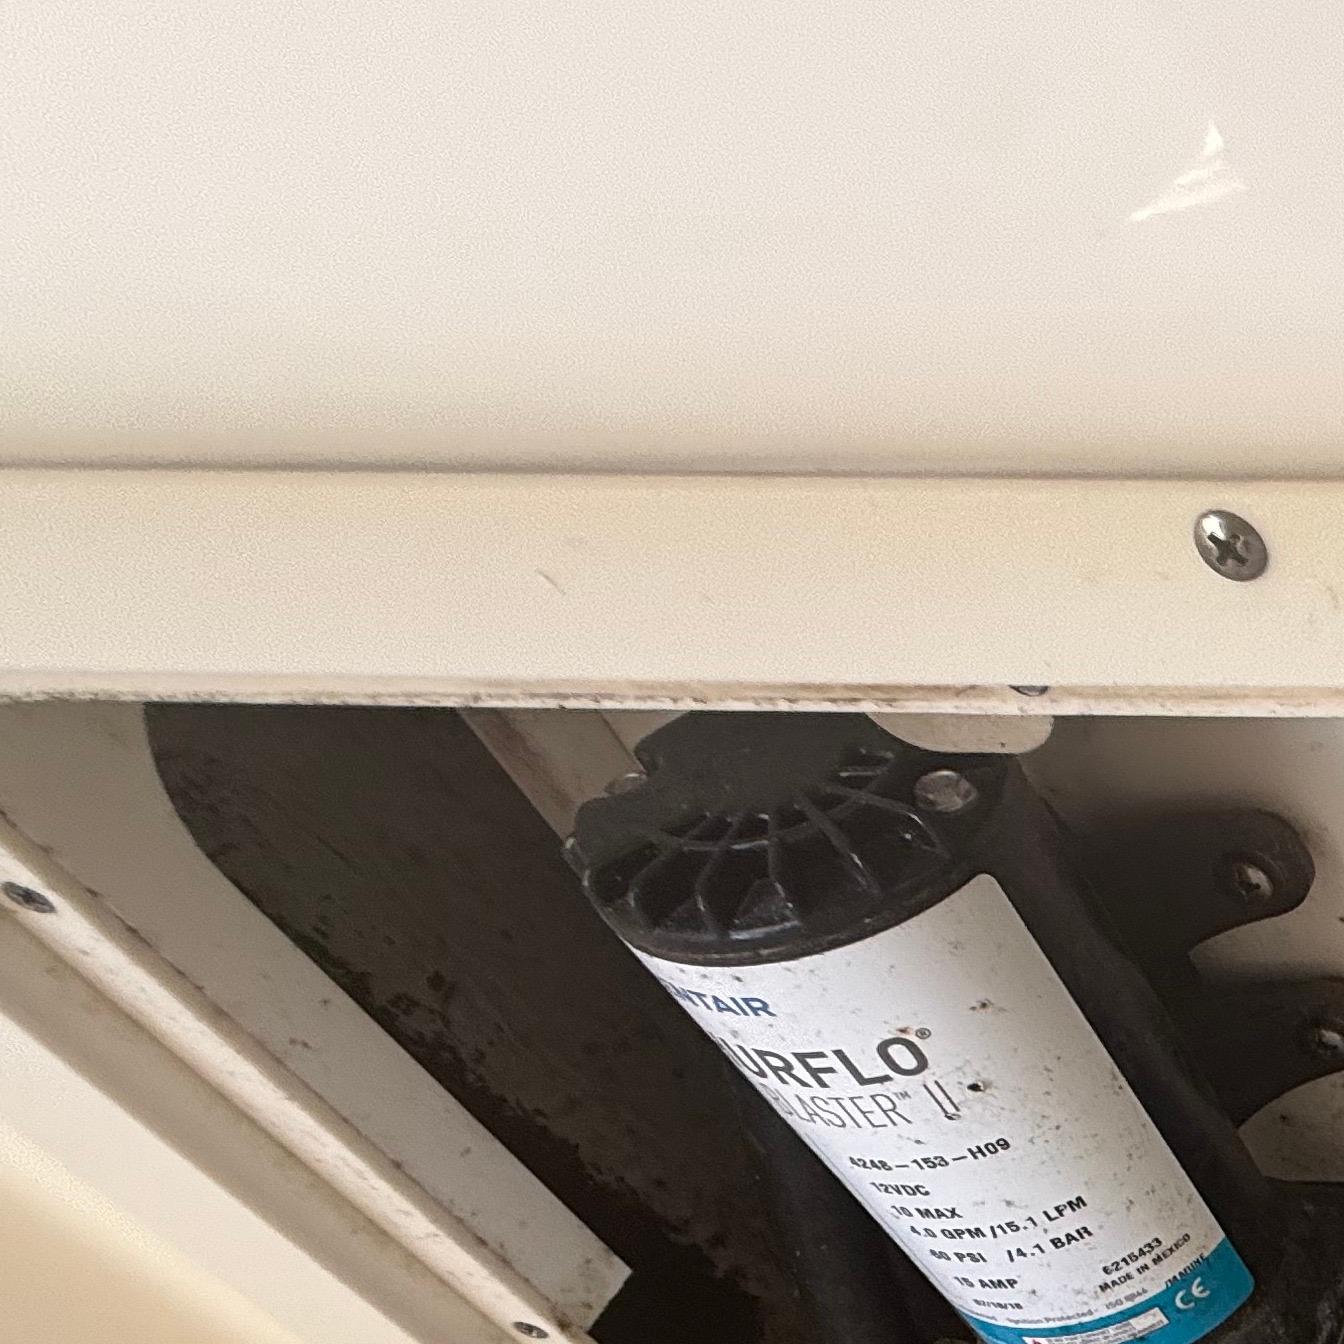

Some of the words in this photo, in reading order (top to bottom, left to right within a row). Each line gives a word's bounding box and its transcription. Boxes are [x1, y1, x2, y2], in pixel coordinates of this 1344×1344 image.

[871, 1182, 931, 1197] 12VDC
[916, 1207, 964, 1220] MAX
[941, 1226, 987, 1240] GPM
[1043, 1195, 1088, 1222] LPM
[957, 1252, 988, 1263] PSI
[1050, 1226, 1094, 1250] BAR
[1099, 1270, 1134, 1293] MADE
[1137, 1262, 1150, 1275] IN
[1153, 1232, 1191, 1267] MEXICO
[978, 1278, 1019, 1289] AMP
